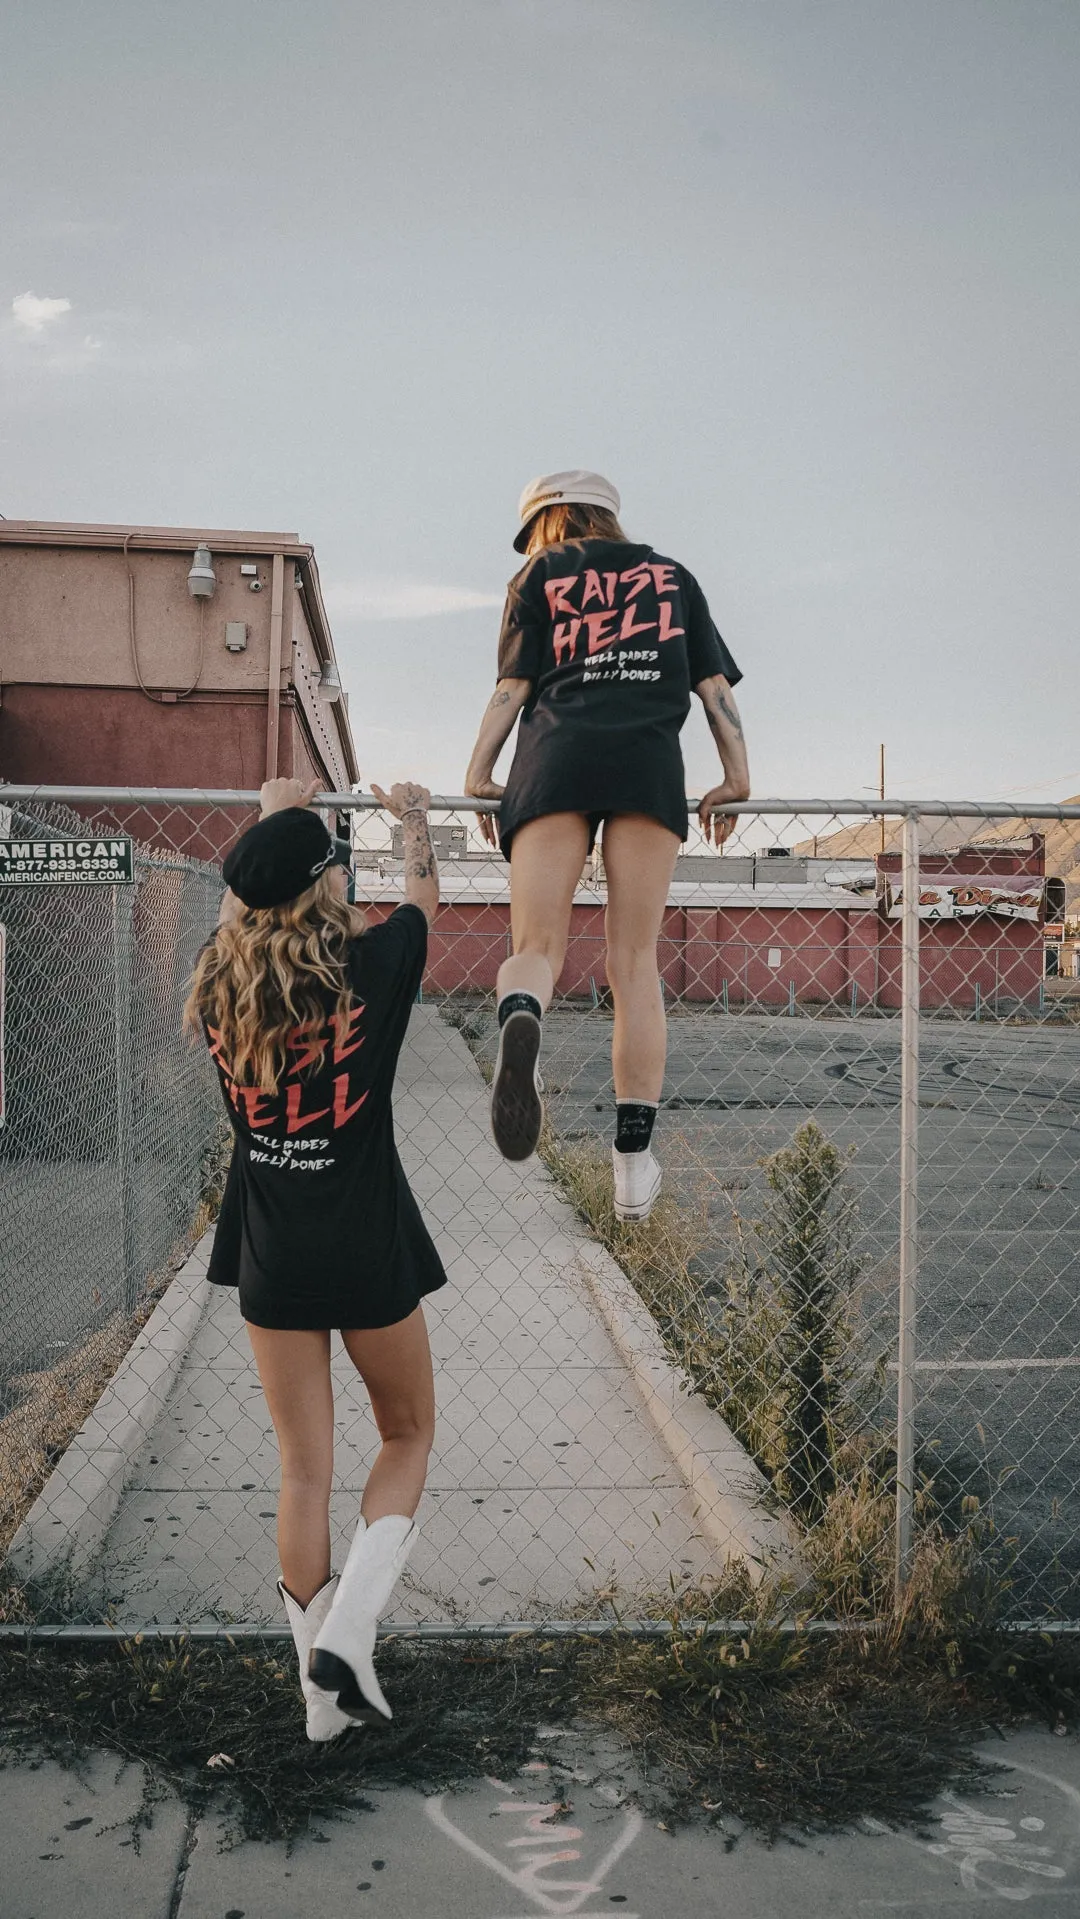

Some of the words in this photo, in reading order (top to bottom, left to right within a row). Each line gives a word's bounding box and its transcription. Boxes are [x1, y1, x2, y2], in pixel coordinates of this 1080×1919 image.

[544, 562, 679, 622] RAISE
[553, 601, 685, 667] HELL
[584, 651, 617, 667] HELL
[0, 842, 126, 858] AMERICAN
[4, 859, 119, 871] 1-877-933-6336
[283, 1138, 330, 1151] BABES
[249, 1149, 288, 1168] BILLY
